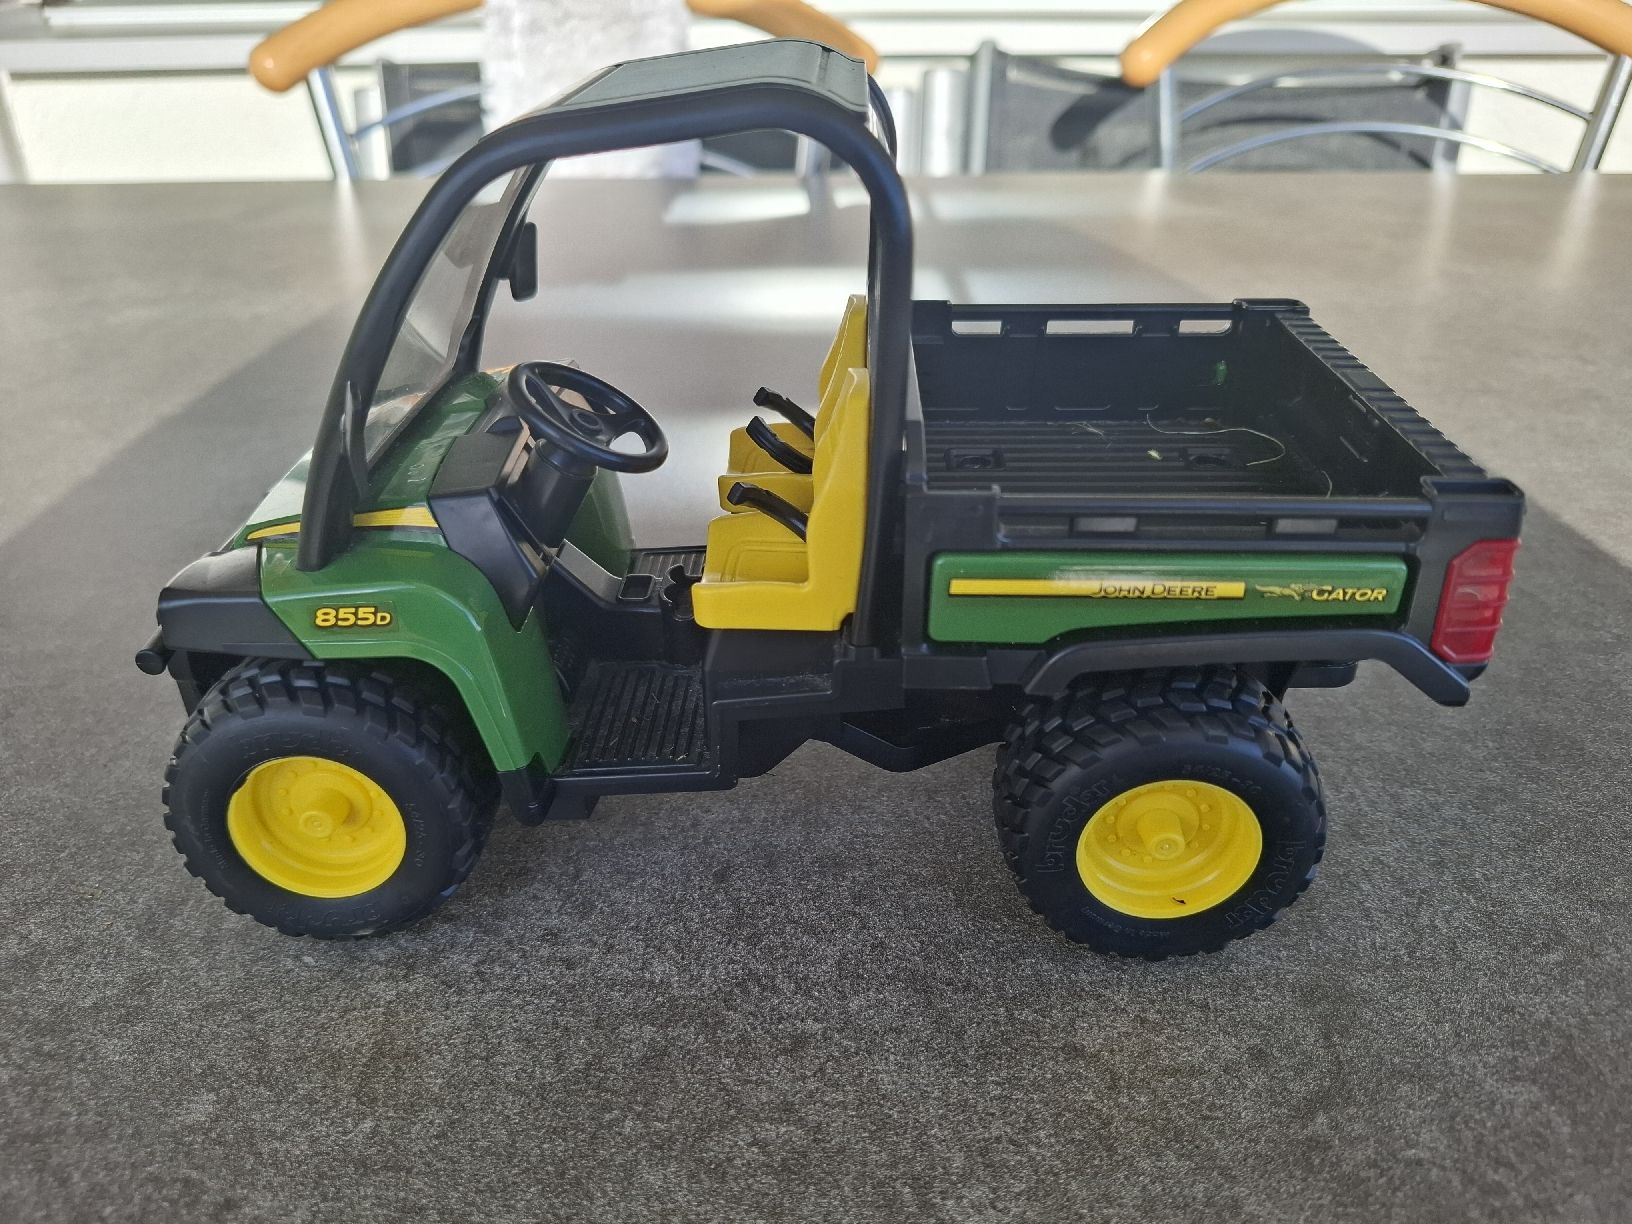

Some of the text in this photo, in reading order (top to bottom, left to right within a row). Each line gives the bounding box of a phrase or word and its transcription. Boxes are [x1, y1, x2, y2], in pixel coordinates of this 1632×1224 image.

[1093, 582, 1217, 597] JOHN DEERE
[1311, 585, 1388, 602] GATOR
[314, 606, 392, 628] 855D
